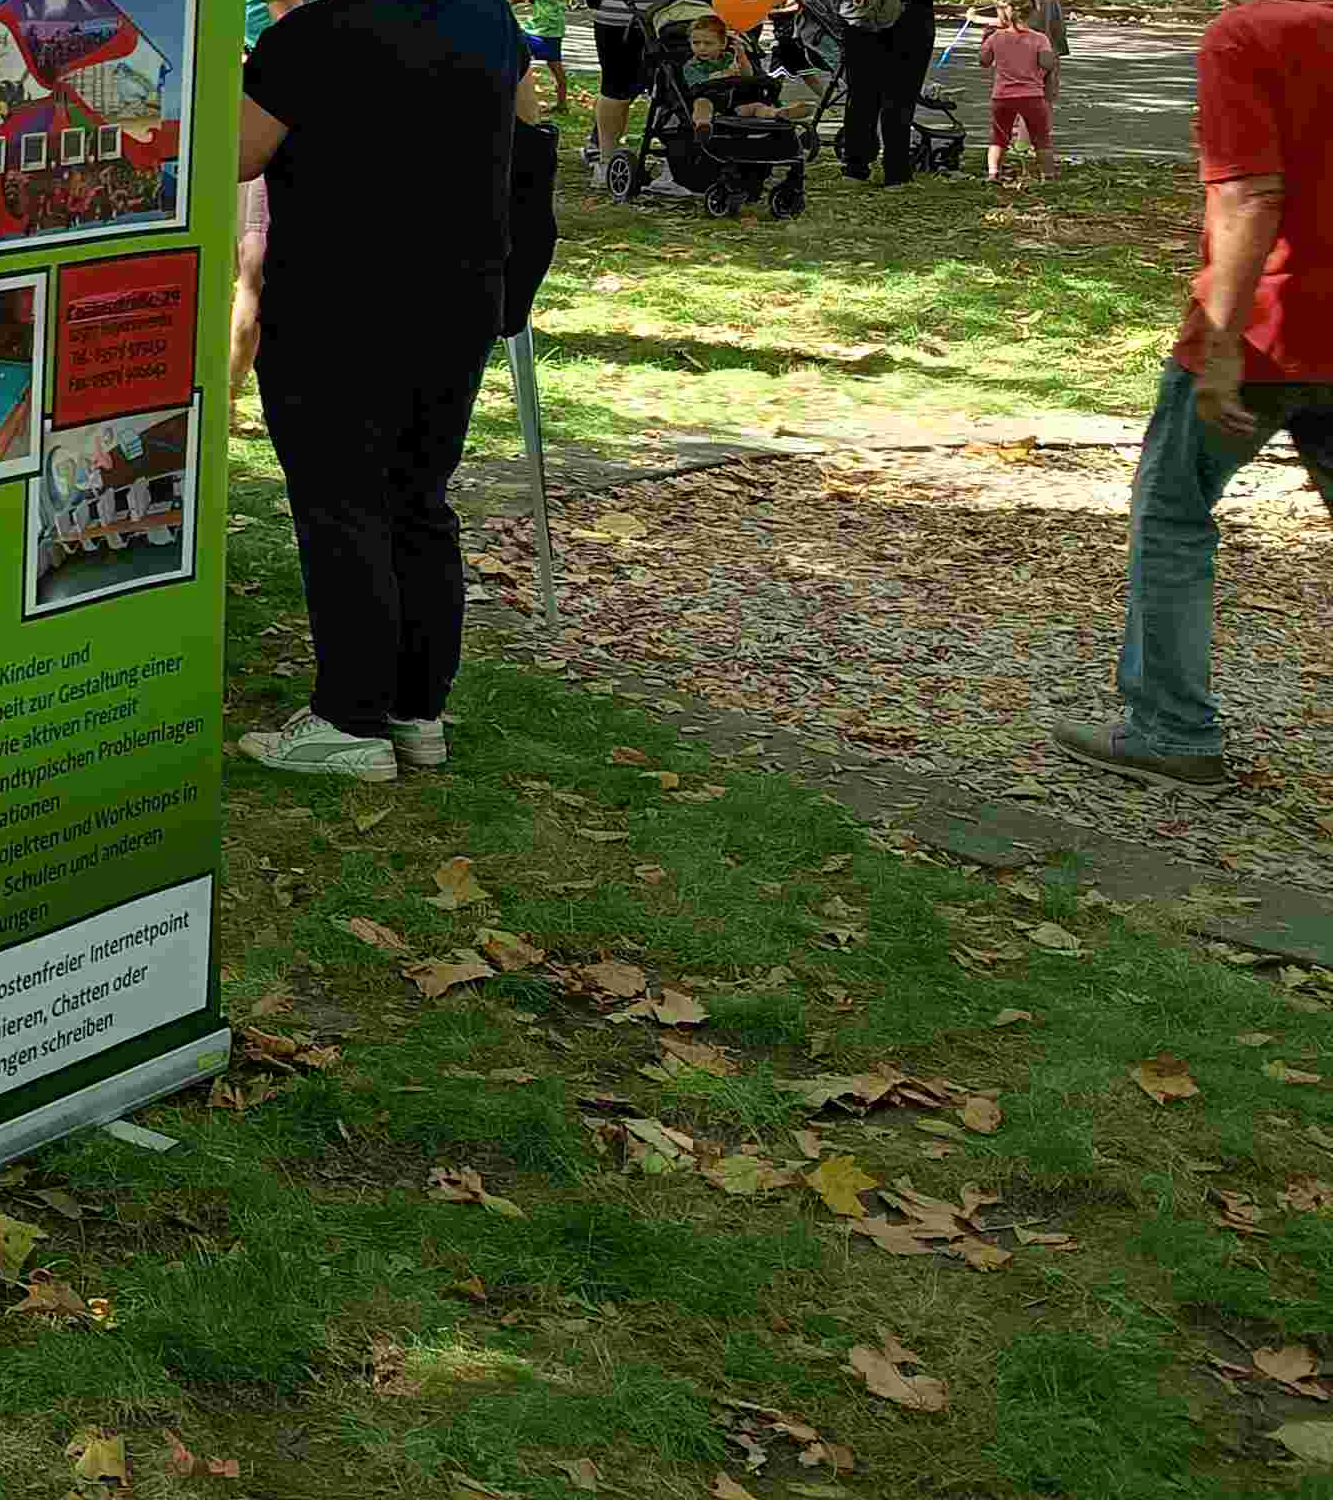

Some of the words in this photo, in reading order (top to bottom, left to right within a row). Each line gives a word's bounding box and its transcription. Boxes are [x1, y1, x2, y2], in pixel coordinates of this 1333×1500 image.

[62, 640, 92, 669] und
[29, 690, 54, 714] zur
[58, 664, 139, 704] Gestaltung
[141, 654, 184, 678] einer
[22, 716, 81, 749] aktiven
[84, 697, 138, 730] Freizeit
[96, 715, 205, 761] Problemlagen
[62, 813, 92, 843] und
[93, 785, 180, 830] Workshops
[182, 781, 198, 804] in
[3, 861, 67, 897] Schulen
[69, 843, 100, 875] und
[100, 826, 164, 861] anderen
[89, 910, 191, 964] Internetpoint
[51, 980, 110, 1019] Chatten
[111, 963, 149, 992] oder
[40, 1012, 114, 1058] schreiben
